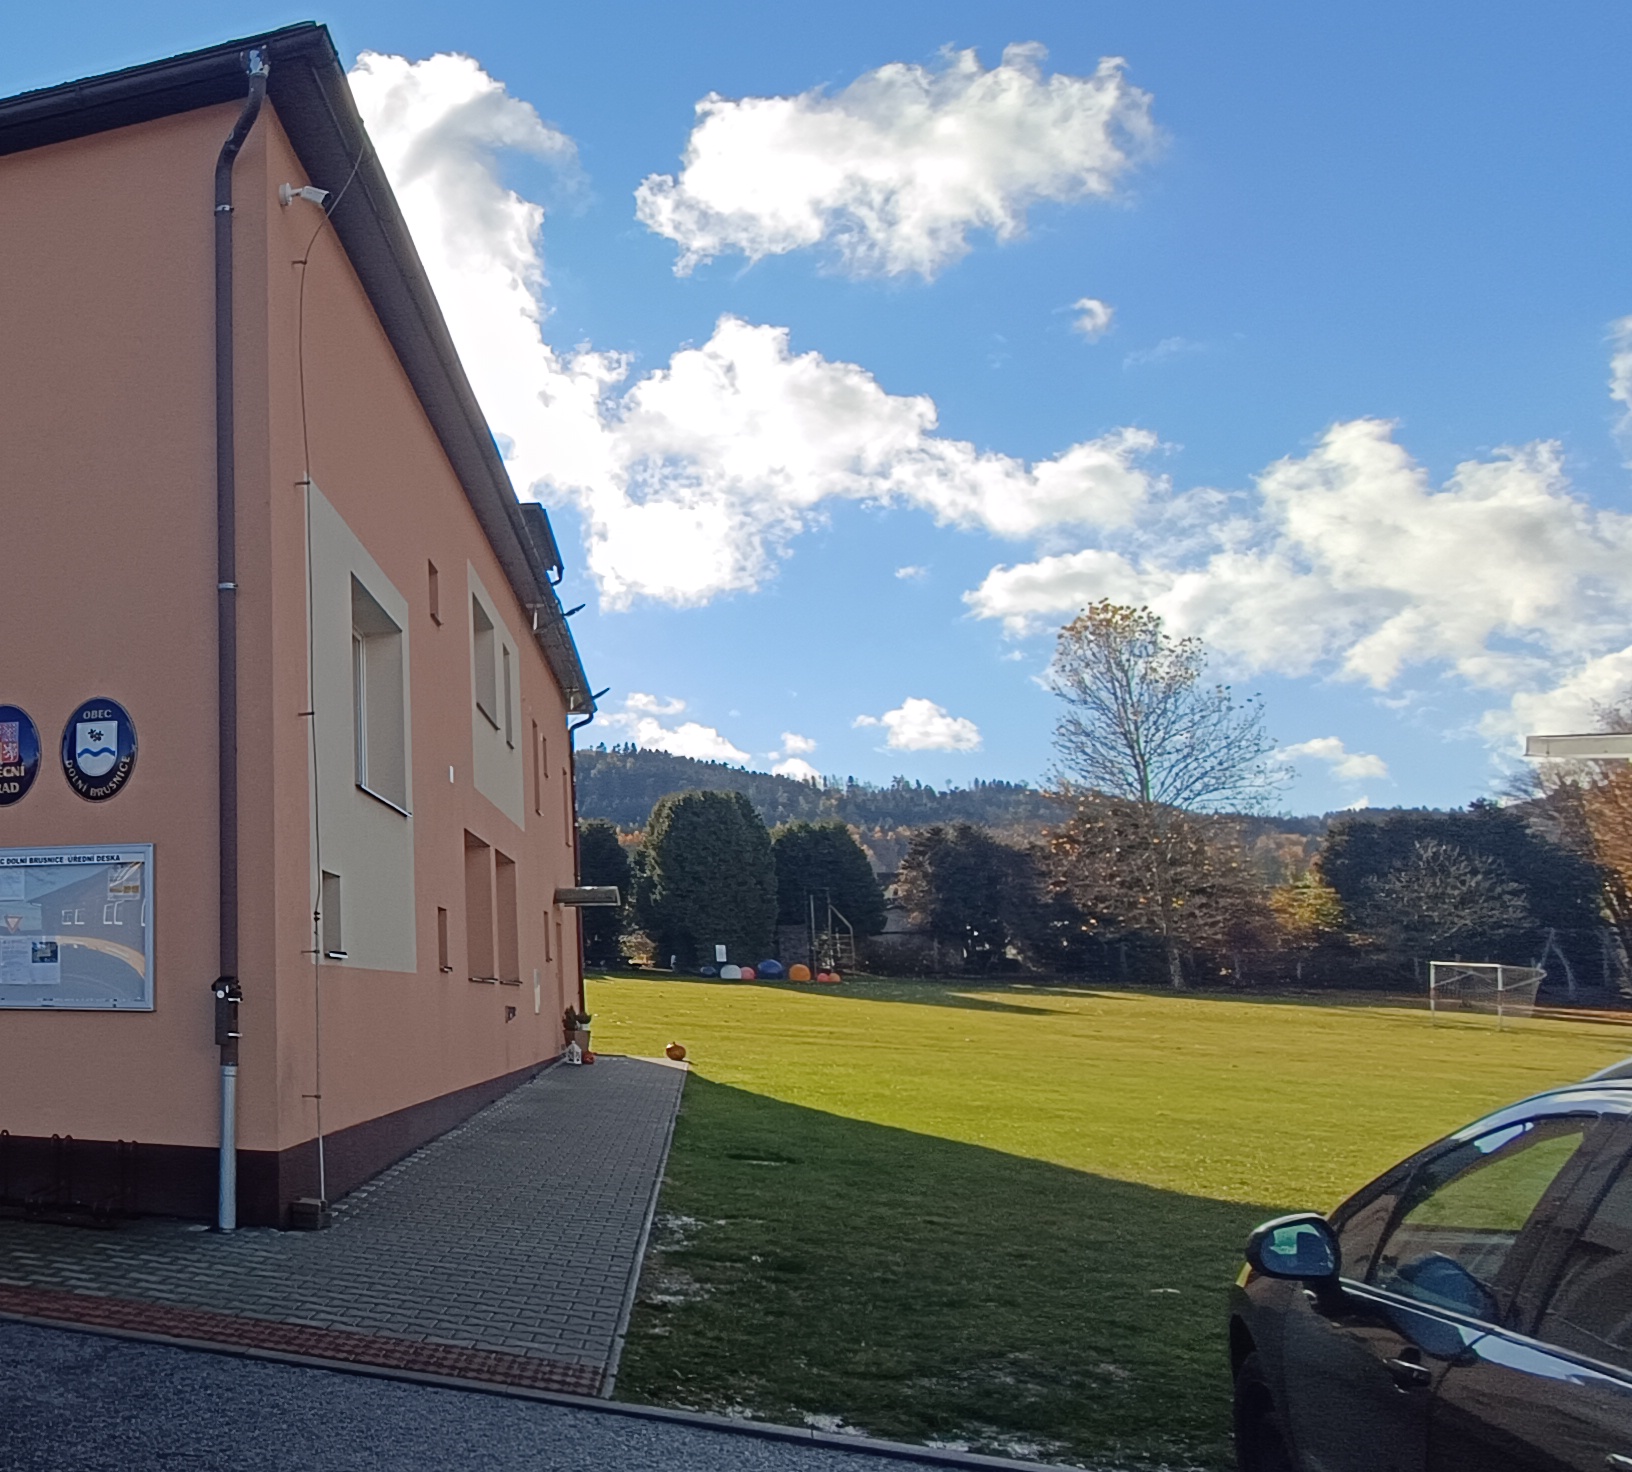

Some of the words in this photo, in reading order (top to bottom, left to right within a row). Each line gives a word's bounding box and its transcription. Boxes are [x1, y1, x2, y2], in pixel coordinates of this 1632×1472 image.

[83, 709, 112, 719] OBEC
[66, 760, 88, 792] DOLNÍ
[90, 755, 131, 796] BRUSNICE
[29, 856, 64, 864] BRUSNICE
